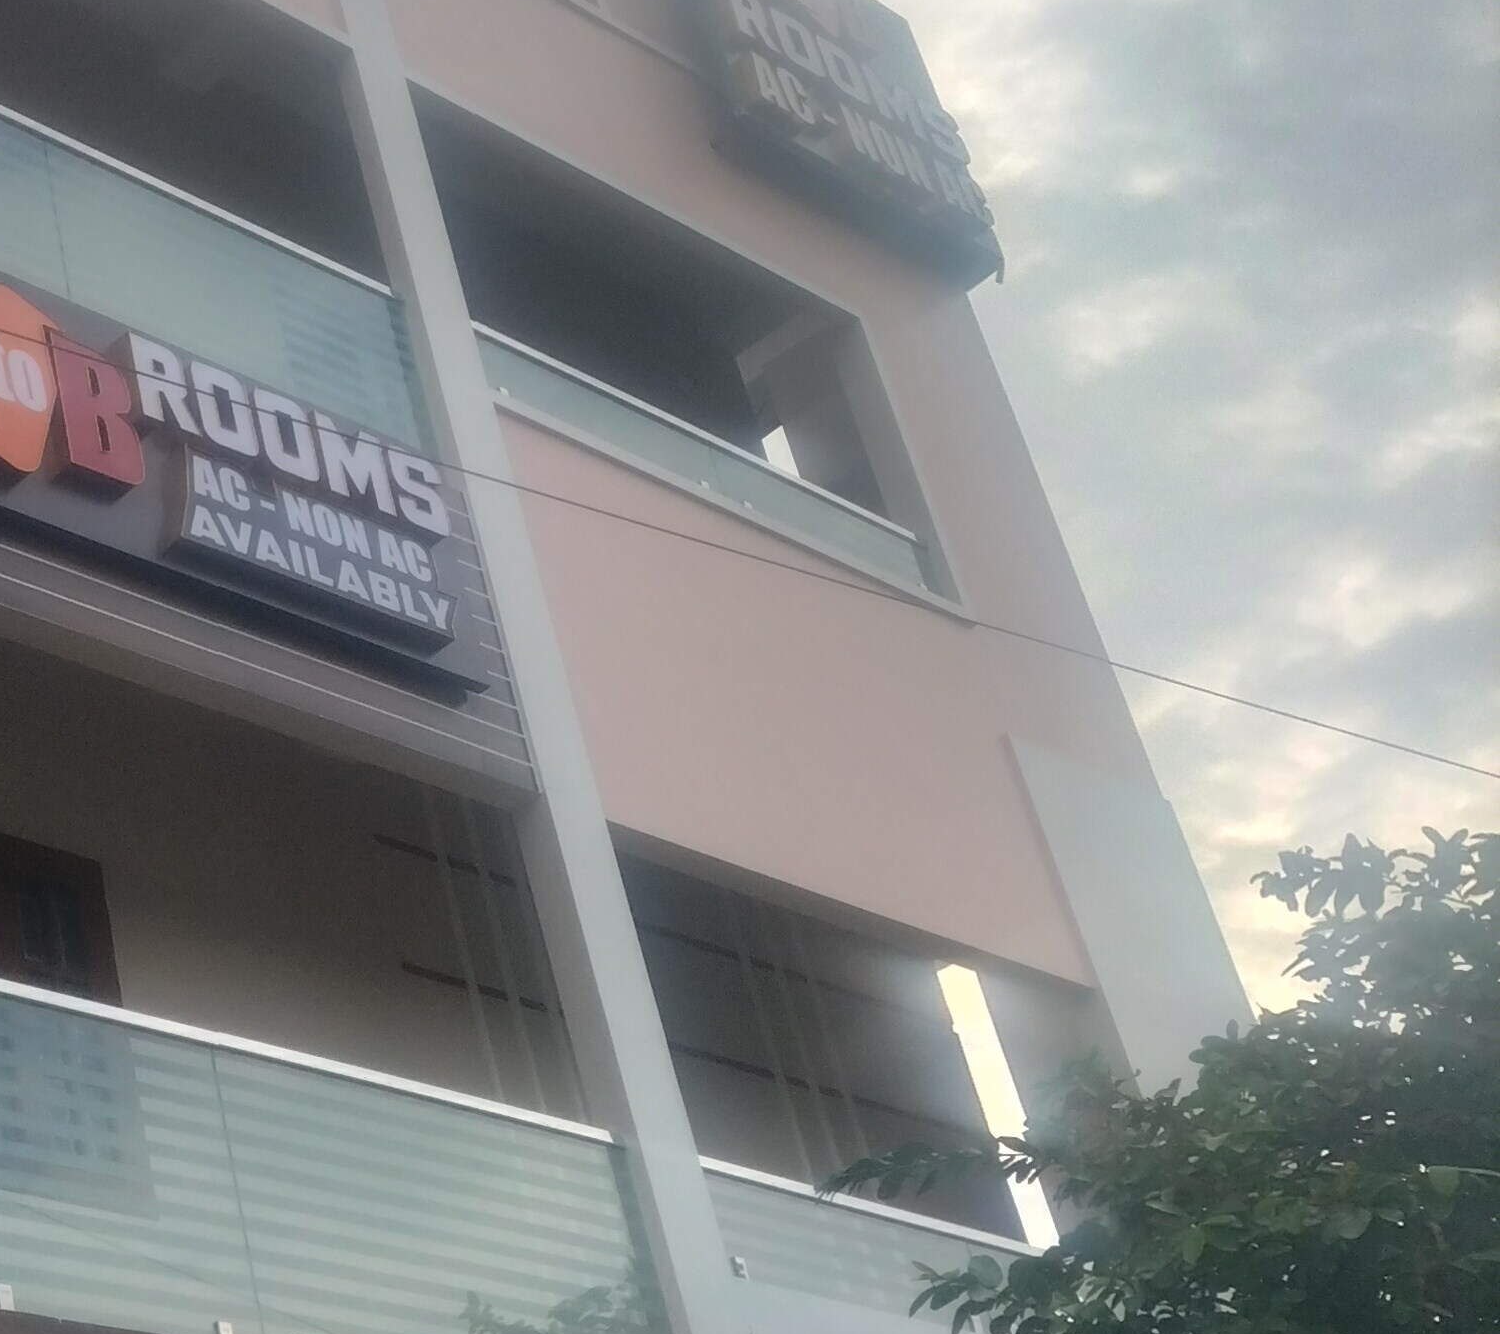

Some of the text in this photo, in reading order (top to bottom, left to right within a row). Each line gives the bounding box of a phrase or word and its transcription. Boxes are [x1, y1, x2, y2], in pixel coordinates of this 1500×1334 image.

[752, 51, 816, 126] AC
[46, 325, 145, 485] B
[128, 331, 451, 536] ROOMS
[190, 504, 450, 631] AVAILABLY
[192, 454, 251, 512] AC
[282, 490, 373, 560] NON
[377, 528, 432, 582] AC
